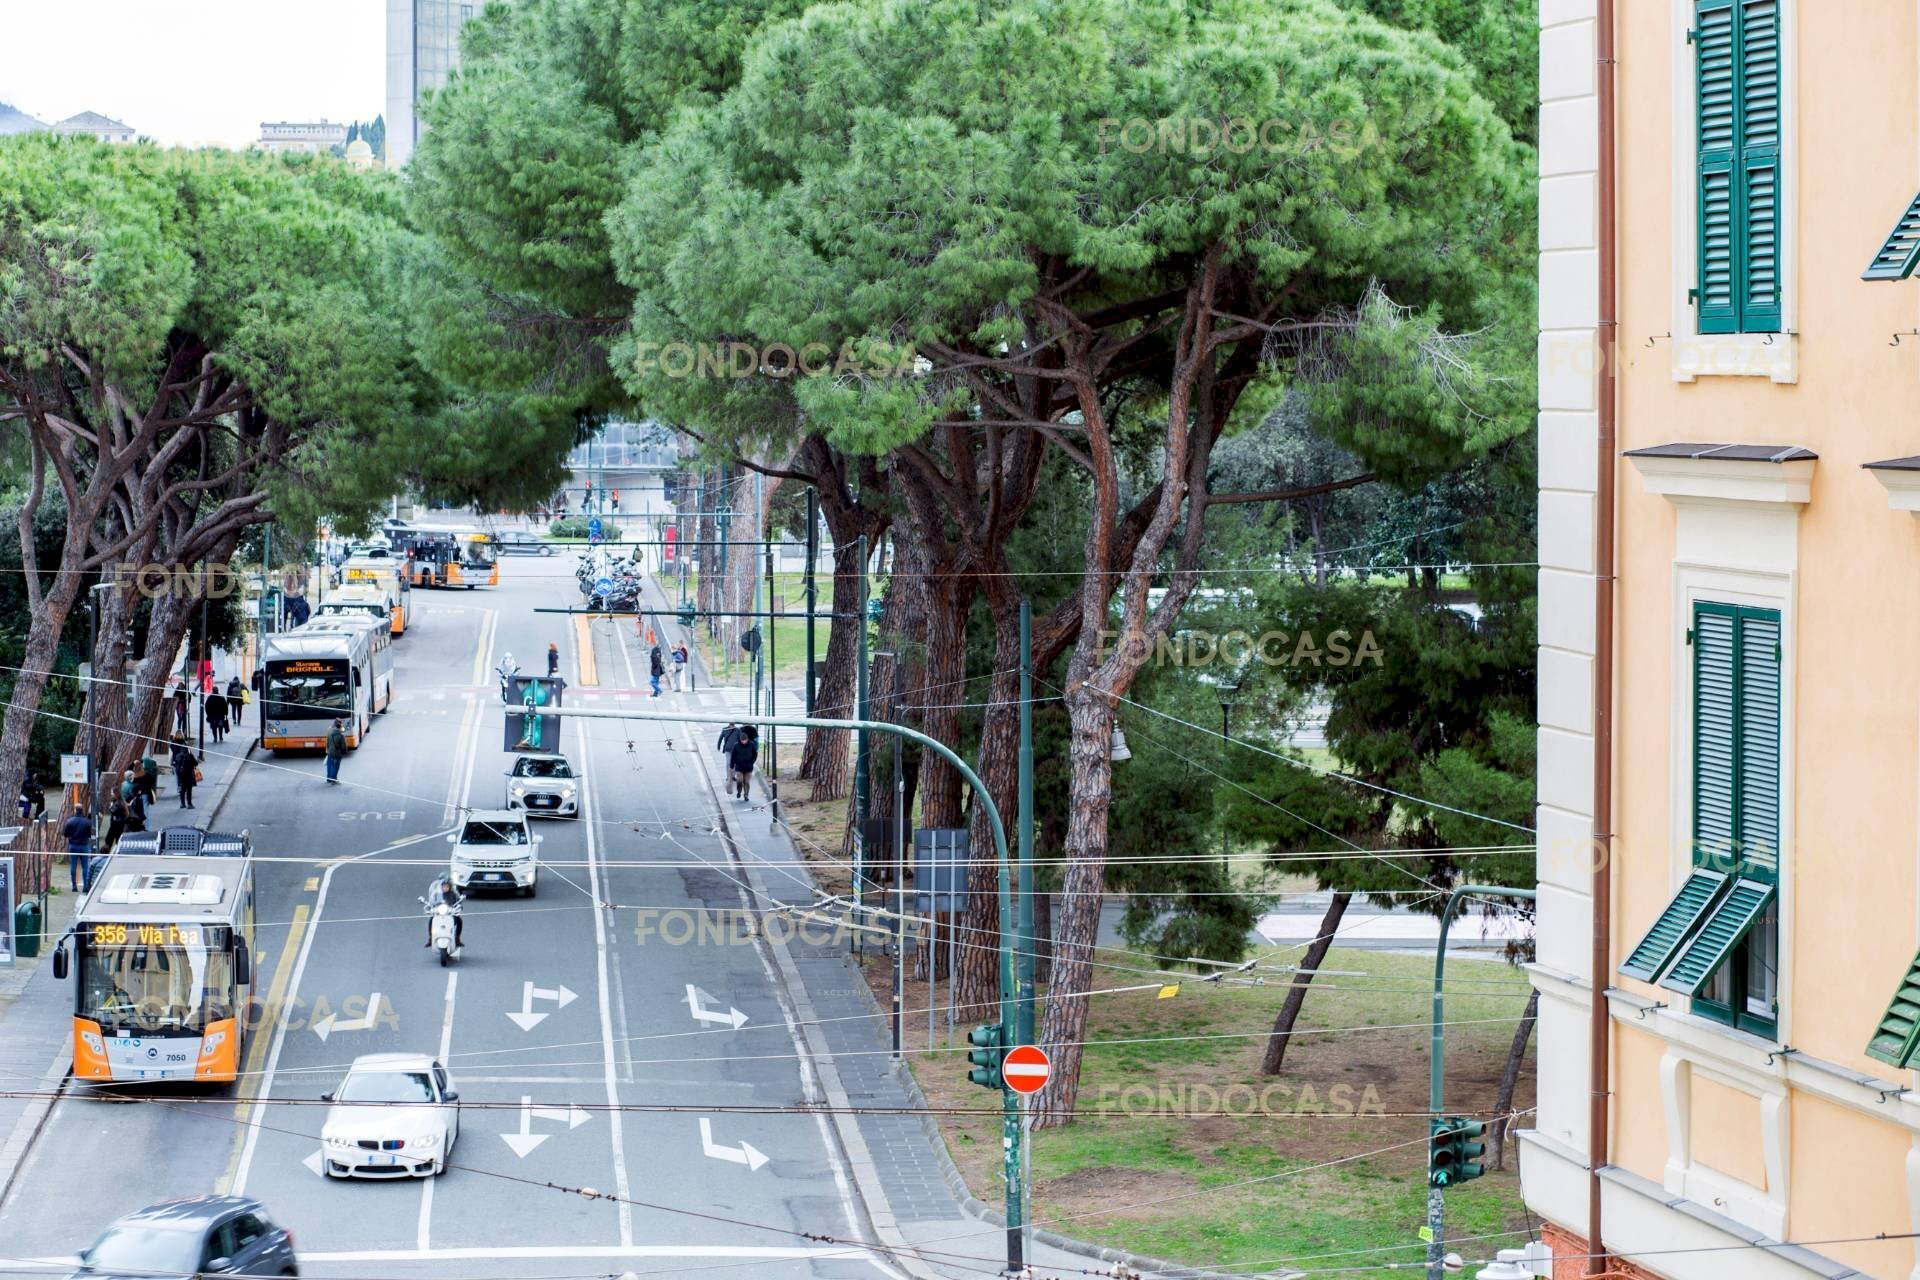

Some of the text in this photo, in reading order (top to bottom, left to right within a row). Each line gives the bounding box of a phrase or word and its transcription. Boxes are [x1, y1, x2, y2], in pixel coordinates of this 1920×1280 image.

[286, 665, 334, 673] BRIGNOLE
[337, 811, 406, 821] BUS
[95, 925, 199, 944] 356 Via Fea
[166, 1054, 187, 1062] 7050
